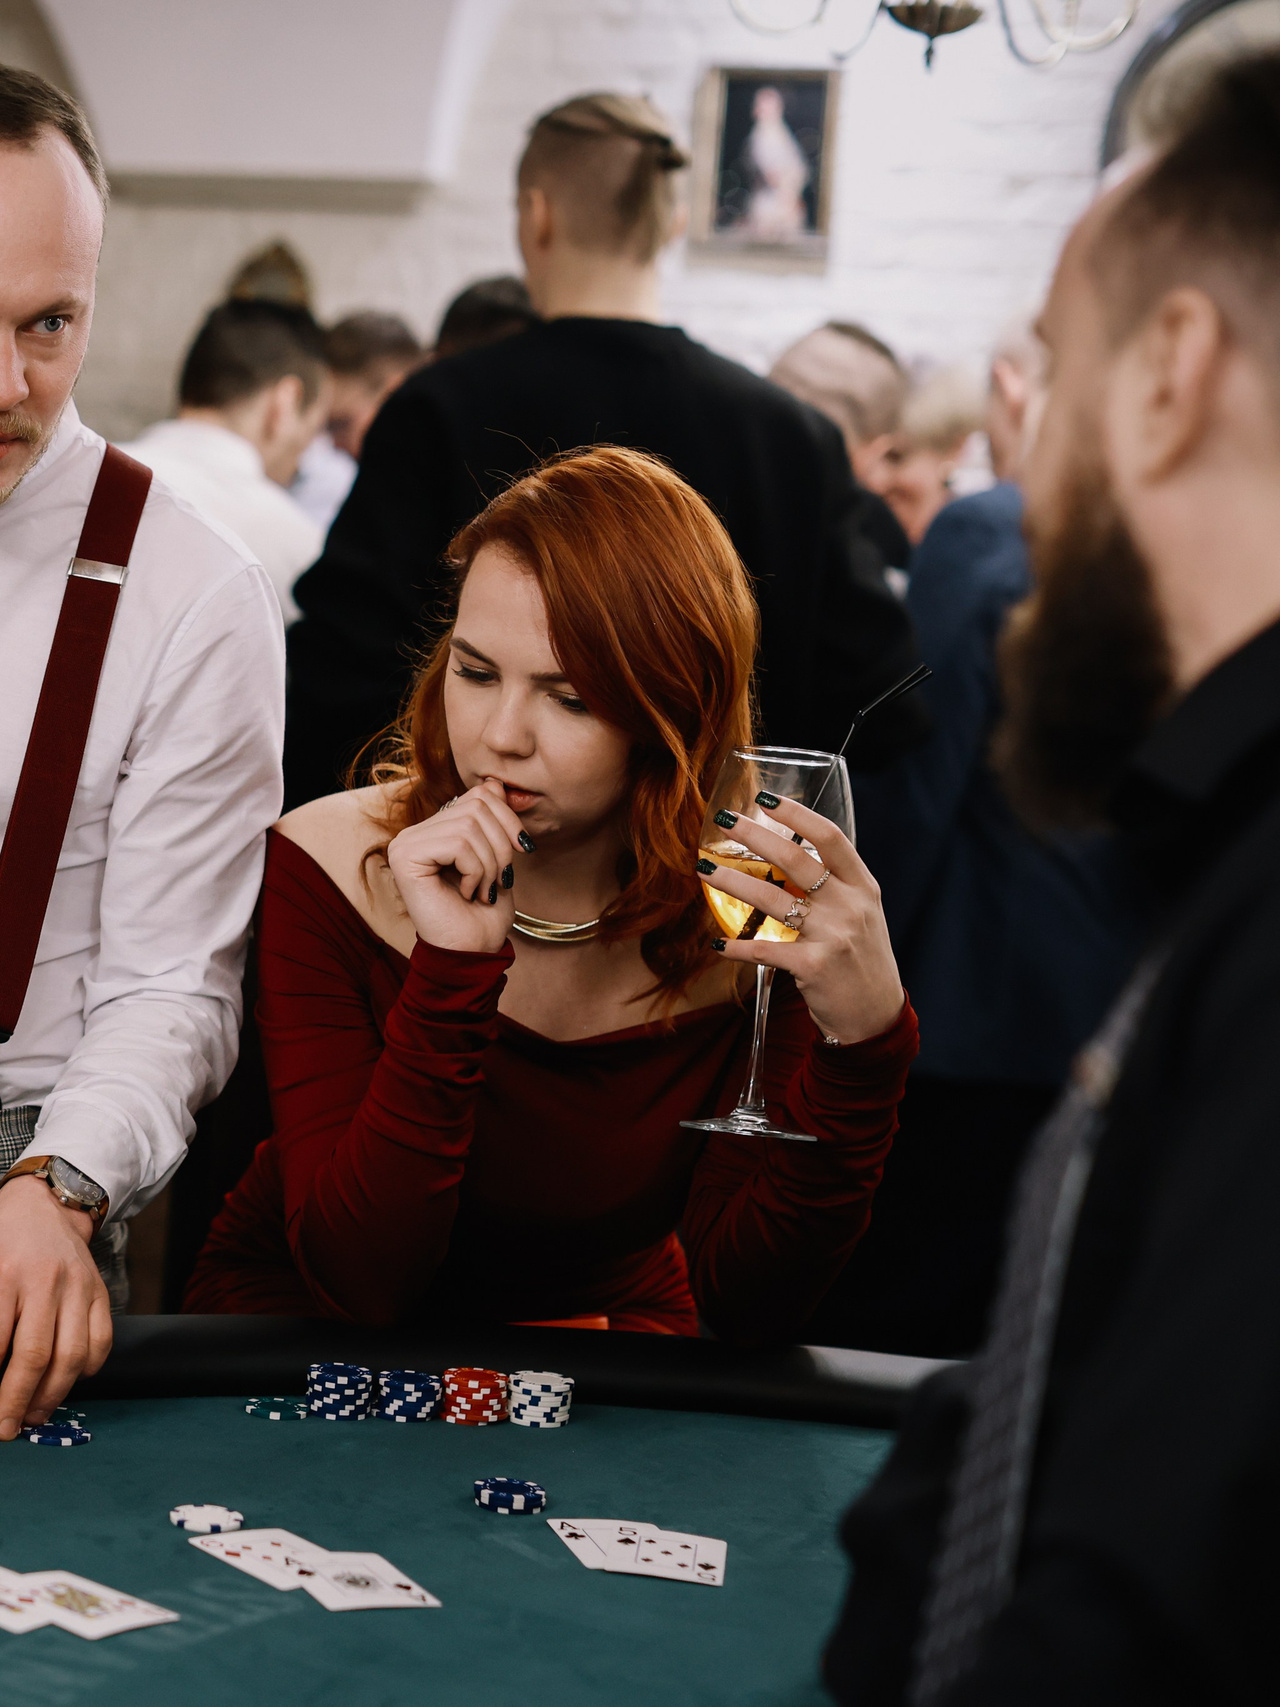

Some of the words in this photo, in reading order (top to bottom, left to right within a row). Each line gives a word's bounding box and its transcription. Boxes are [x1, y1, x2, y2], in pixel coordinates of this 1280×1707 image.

[559, 1521, 580, 1531] A
[618, 1526, 638, 1537] 5
[697, 1572, 716, 1582] 5
